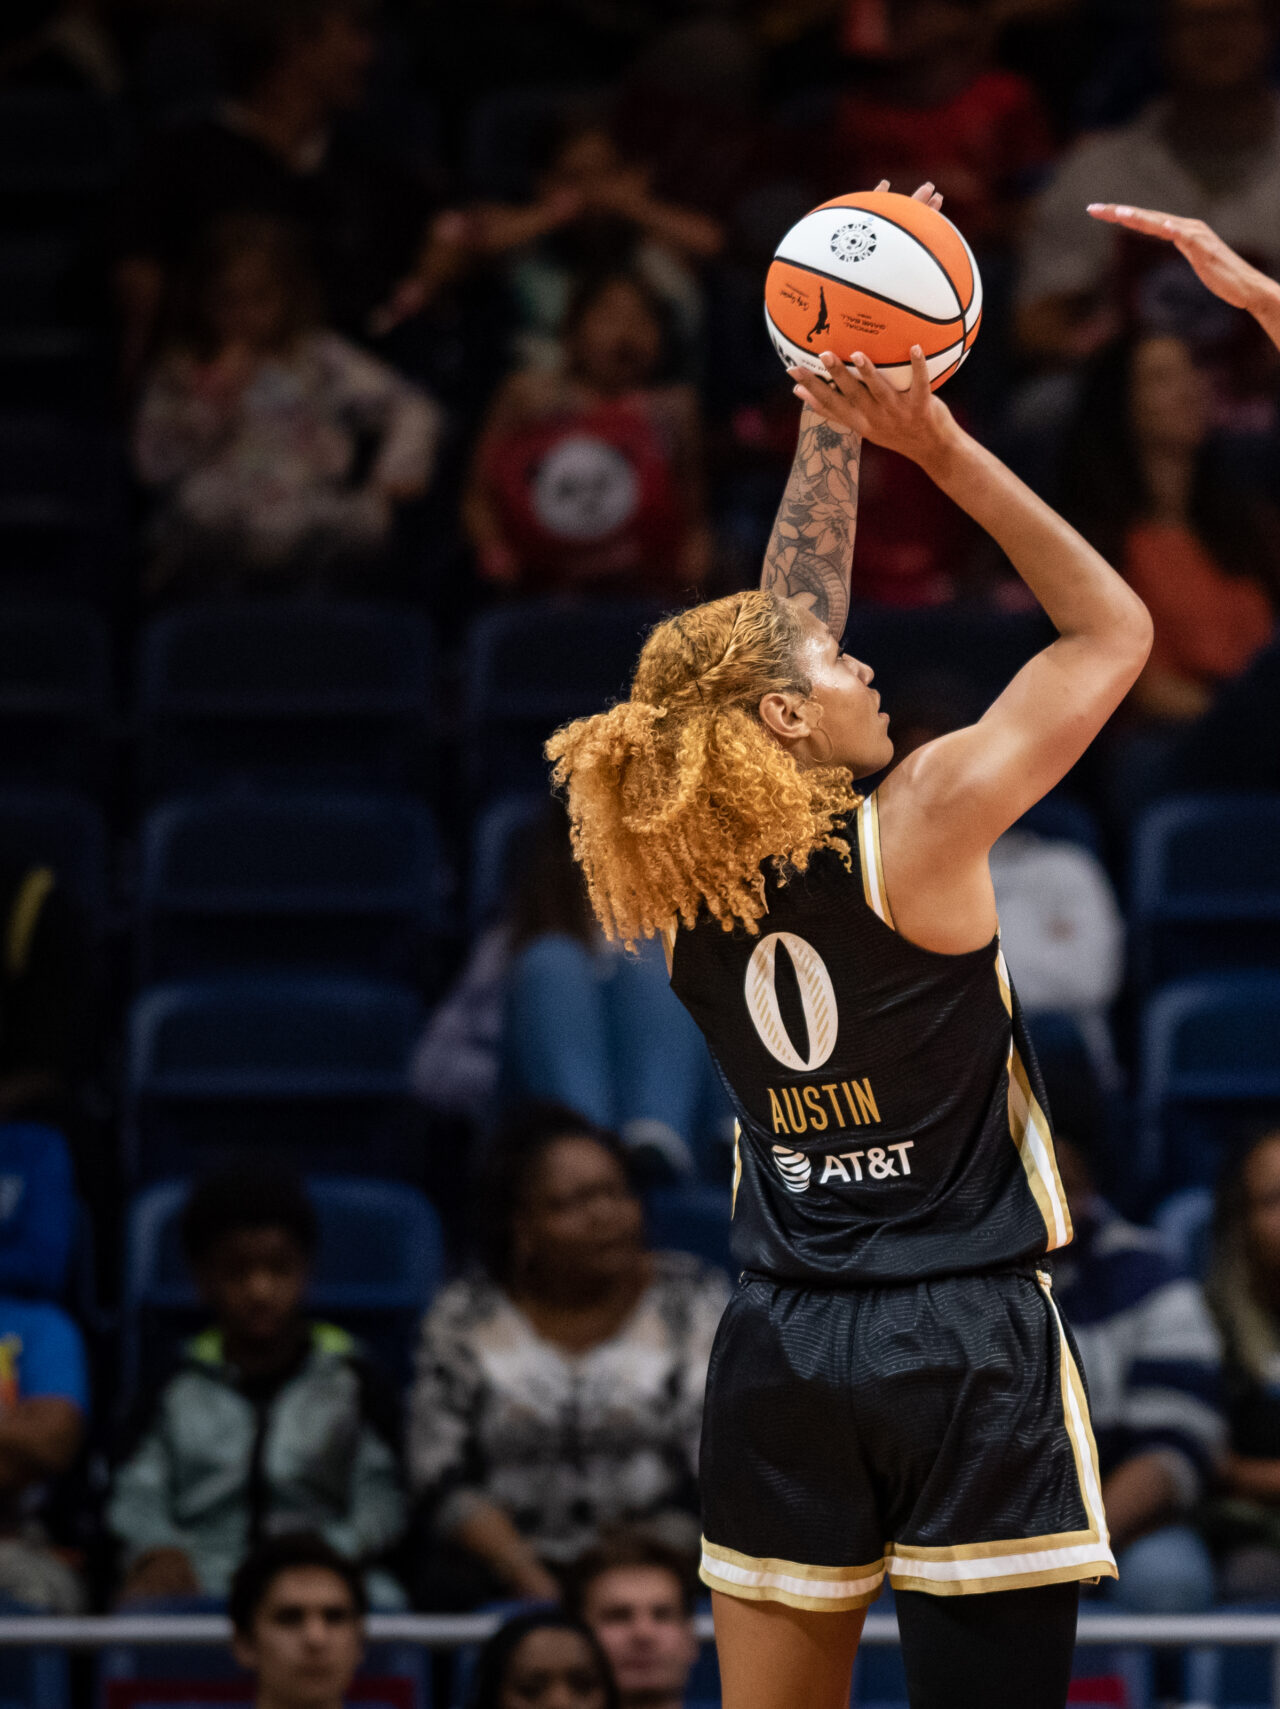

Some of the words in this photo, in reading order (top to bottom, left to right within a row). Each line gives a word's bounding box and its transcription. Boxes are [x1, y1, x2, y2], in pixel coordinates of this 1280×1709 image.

[744, 931, 838, 1071] 0
[767, 1077, 881, 1134] AUSTIN
[819, 1140, 915, 1184] AT&T
